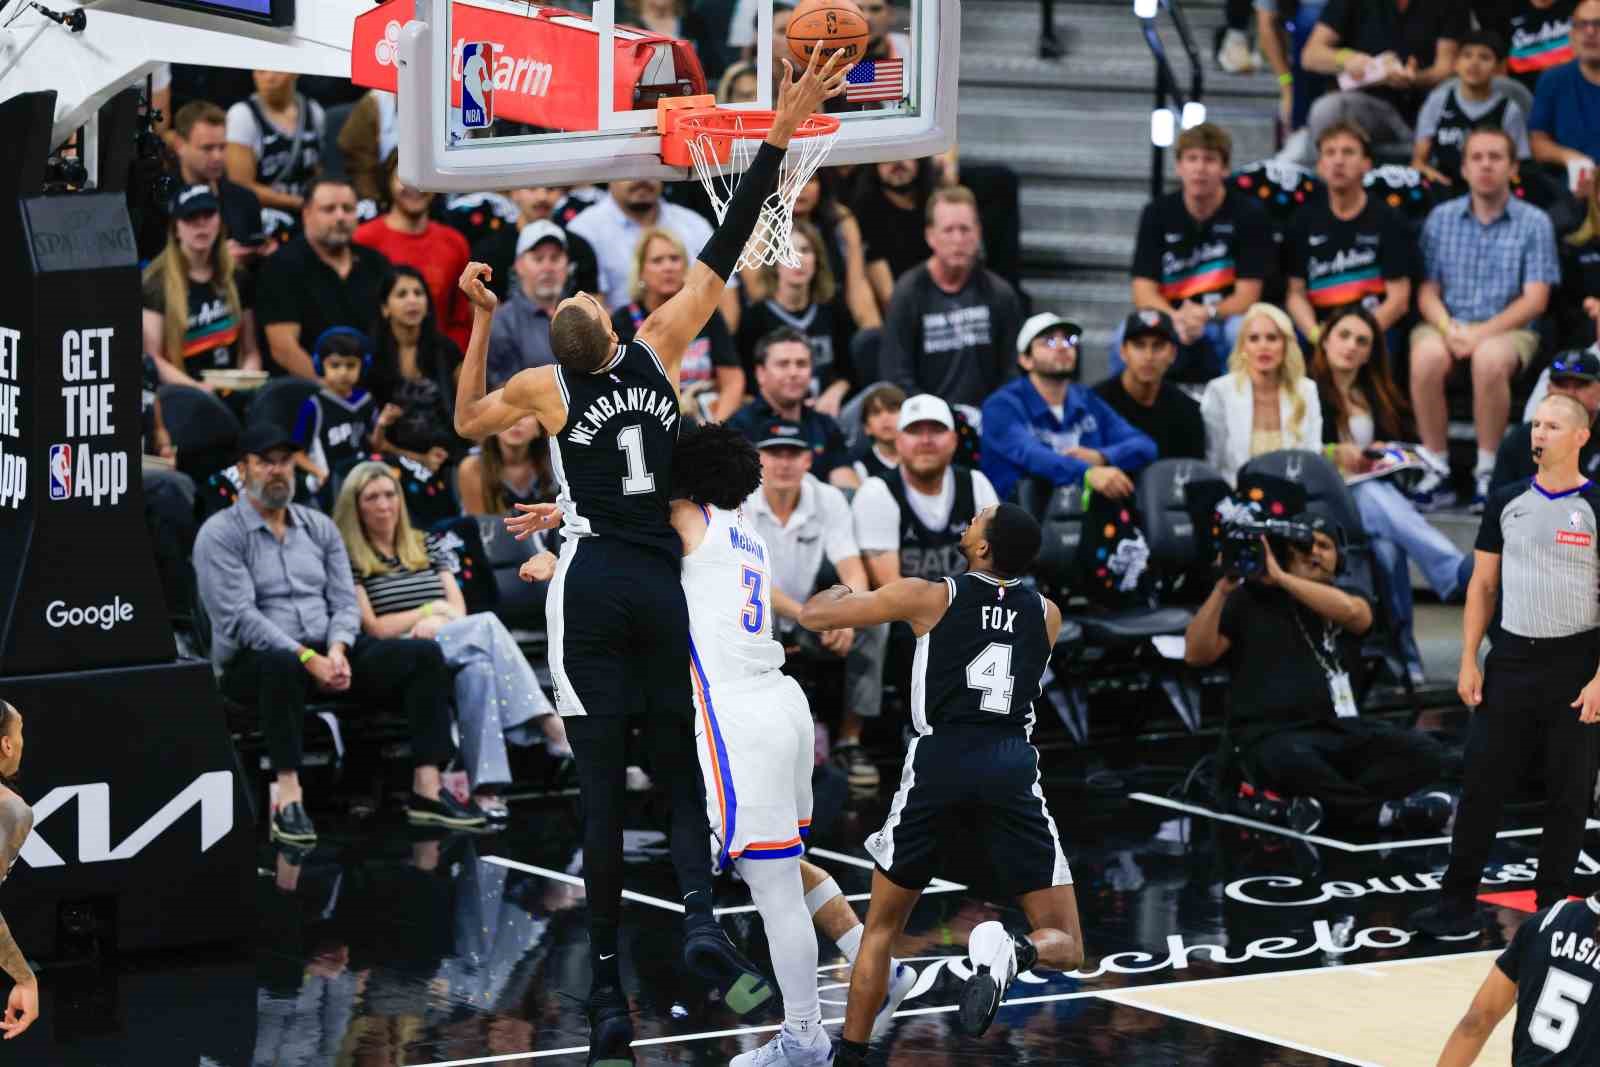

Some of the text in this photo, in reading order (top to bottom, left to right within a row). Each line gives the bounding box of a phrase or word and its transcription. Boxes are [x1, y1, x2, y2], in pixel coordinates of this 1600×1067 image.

[465, 108, 481, 124] NBA
[34, 226, 133, 257] SPANG
[0, 326, 21, 381] ET
[62, 327, 114, 382] GET
[0, 382, 21, 438] HE
[61, 383, 115, 438] THE
[567, 387, 677, 446] WEMBANYAMA
[0, 439, 27, 509] pp
[74, 443, 128, 507] App
[616, 423, 656, 495] 1
[46, 595, 134, 630] Google
[740, 564, 767, 636] 3
[981, 605, 1018, 633] FOX
[966, 642, 1015, 715] 4
[1528, 965, 1594, 1054] 5
